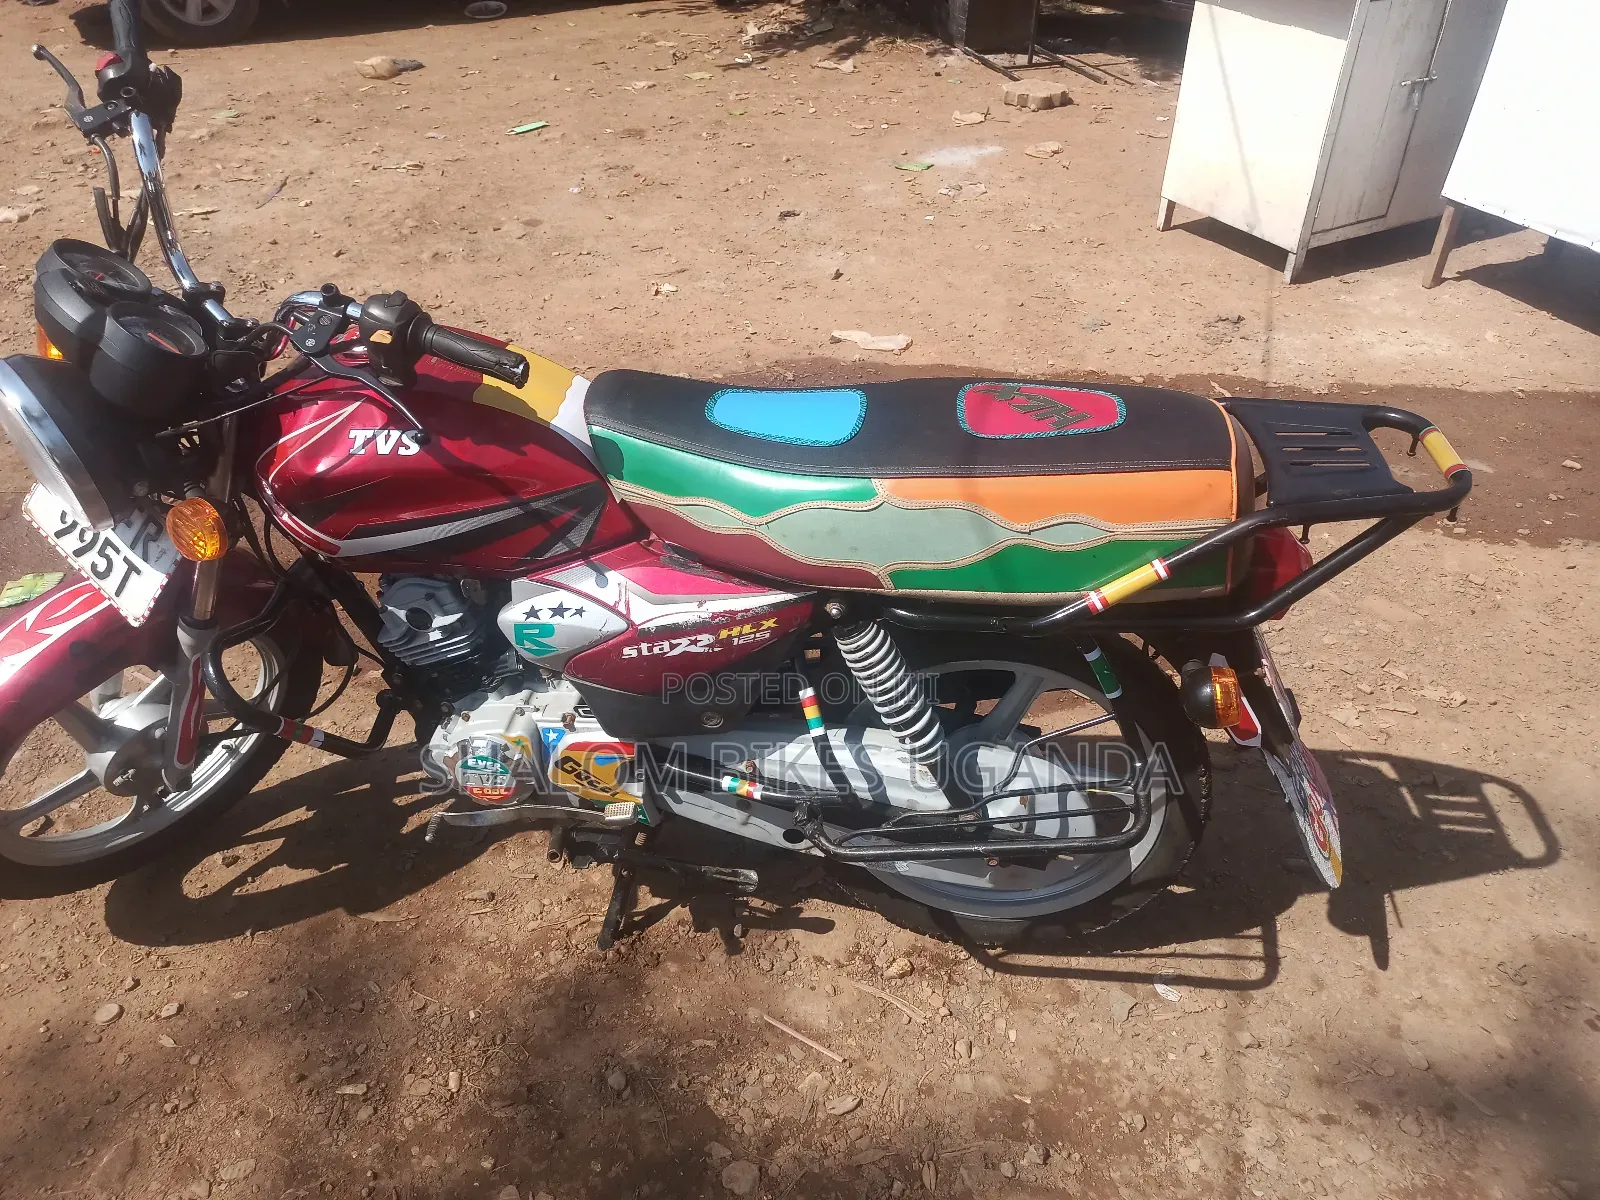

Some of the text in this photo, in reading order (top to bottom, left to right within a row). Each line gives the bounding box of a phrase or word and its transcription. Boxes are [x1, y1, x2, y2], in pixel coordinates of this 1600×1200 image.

[348, 429, 421, 456] TVS
[718, 618, 779, 639] HLX
[732, 629, 772, 646] 125
